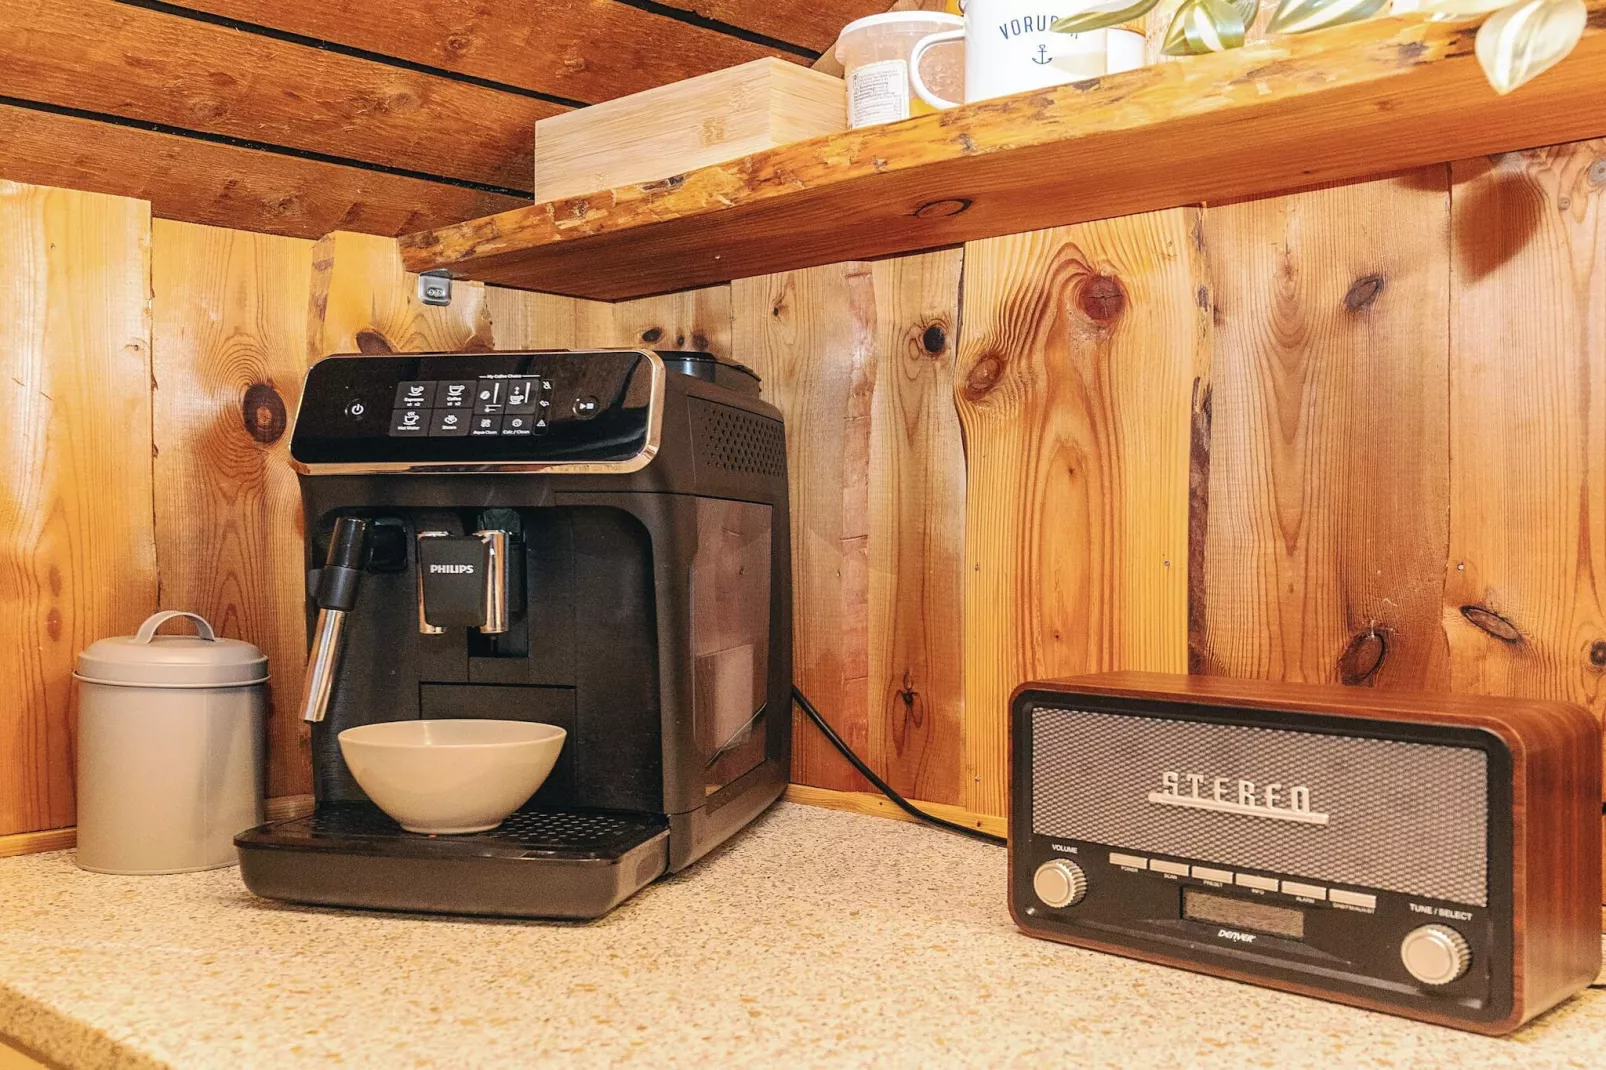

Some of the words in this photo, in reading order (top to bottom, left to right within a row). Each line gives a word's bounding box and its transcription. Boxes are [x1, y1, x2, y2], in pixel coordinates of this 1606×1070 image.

[430, 564, 474, 574] PHILIPS
[1162, 771, 1311, 814] STEREO
[1051, 843, 1078, 854] VOLUME
[1409, 902, 1433, 915] TUNE
[1438, 907, 1473, 921] SELECT
